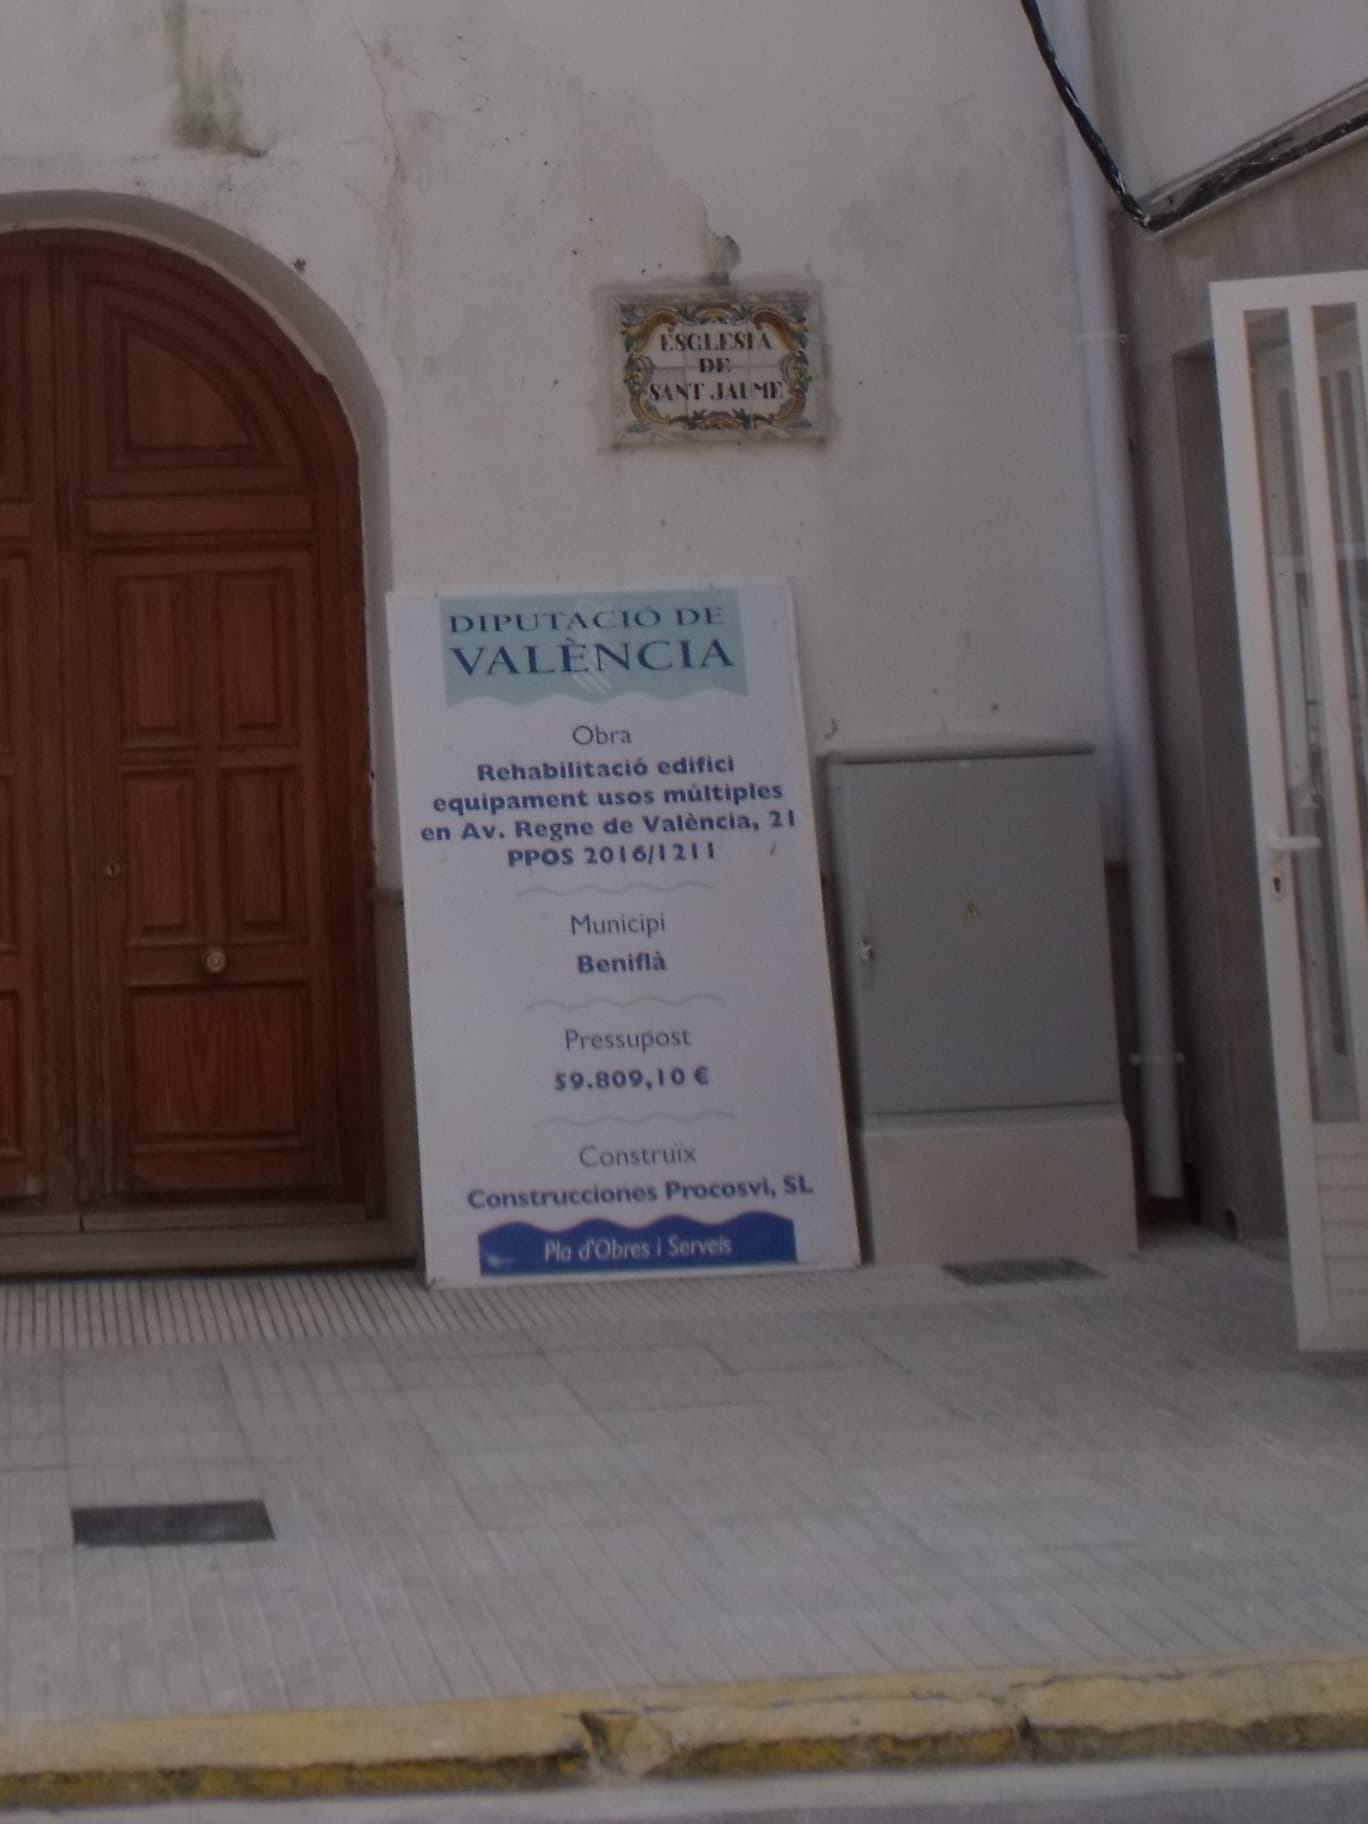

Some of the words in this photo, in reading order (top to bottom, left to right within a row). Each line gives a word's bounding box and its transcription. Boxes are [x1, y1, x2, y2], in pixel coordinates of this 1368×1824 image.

[660, 331, 771, 352] ESGLESIA
[699, 358, 730, 373] DE
[650, 382, 704, 401] SANT
[710, 381, 782, 400] JAUME
[449, 605, 661, 633] DIPUTACIÓ
[675, 606, 726, 626] DE
[450, 637, 735, 676] VALÈNCIA
[572, 725, 632, 746] Obra
[476, 756, 649, 783] Rehabilitació
[657, 754, 735, 776] edifici
[432, 789, 589, 818] equipament
[598, 789, 654, 807] usos
[663, 783, 784, 810] múltiples
[421, 825, 451, 842] en
[461, 822, 505, 841] Av.
[515, 820, 593, 843] Regne
[603, 817, 632, 835] de
[643, 813, 760, 834] València,
[769, 811, 796, 828] 21
[508, 848, 574, 868] PPOS
[584, 842, 715, 866] 2016/1211
[570, 912, 666, 938] Municipi
[577, 951, 667, 975] Beniflà
[565, 1028, 692, 1052] Pressupost
[554, 1067, 685, 1091] 59.809,10
[694, 1066, 709, 1085] €
[467, 1185, 657, 1210] Construcciones
[666, 1177, 776, 1201] Procosvi,
[783, 1175, 814, 1195] SL
[544, 1239, 572, 1261] Pla
[579, 1237, 650, 1259] d'Obres
[656, 1237, 662, 1256] i
[668, 1235, 732, 1256] Serveis
